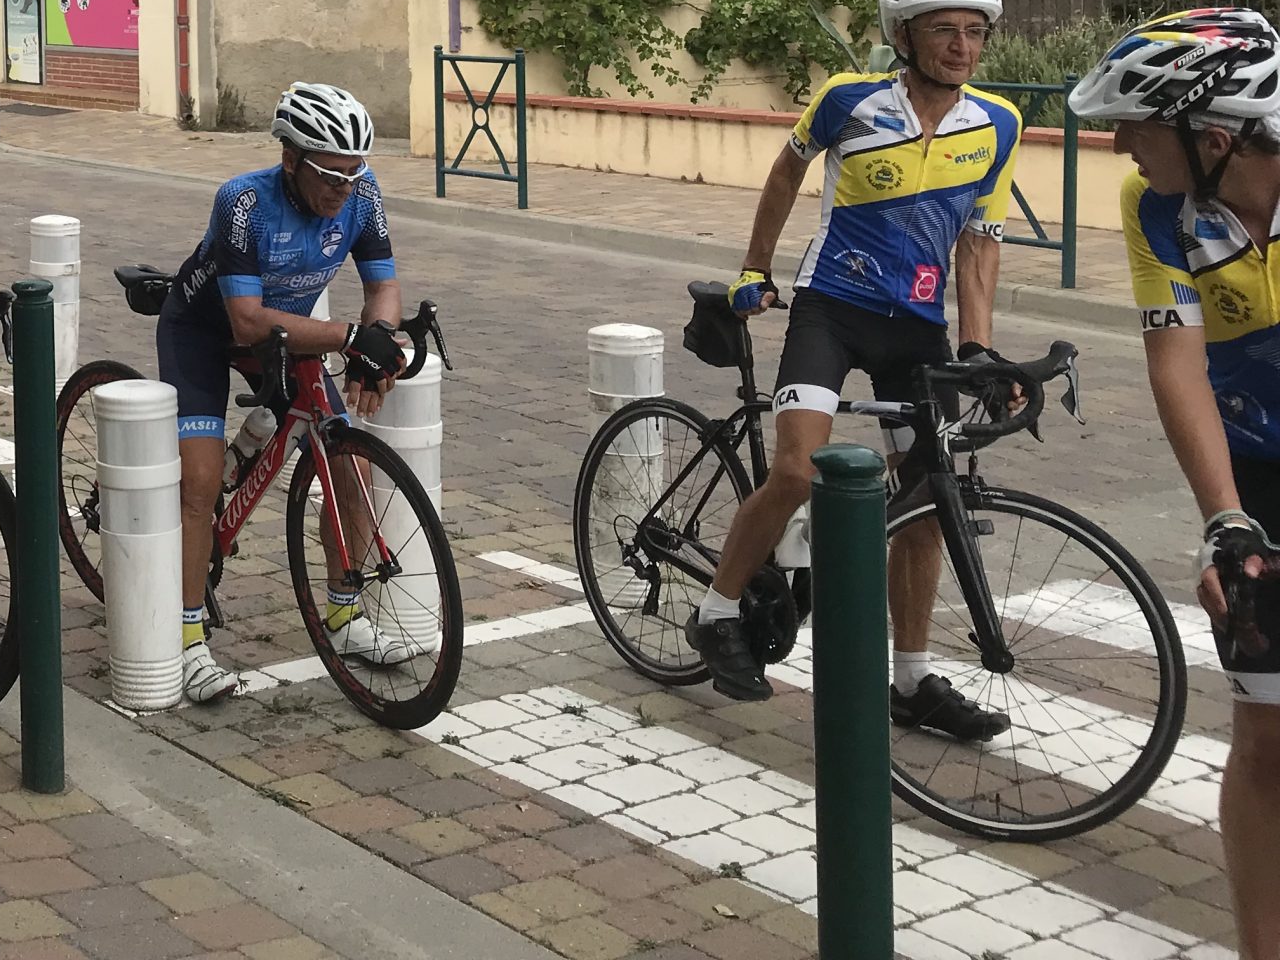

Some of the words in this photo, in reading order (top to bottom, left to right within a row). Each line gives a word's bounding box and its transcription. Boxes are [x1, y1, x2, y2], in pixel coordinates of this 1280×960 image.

[1162, 62, 1228, 120] SCOTT
[982, 223, 1003, 237] VC
[218, 439, 279, 532] Wilier
